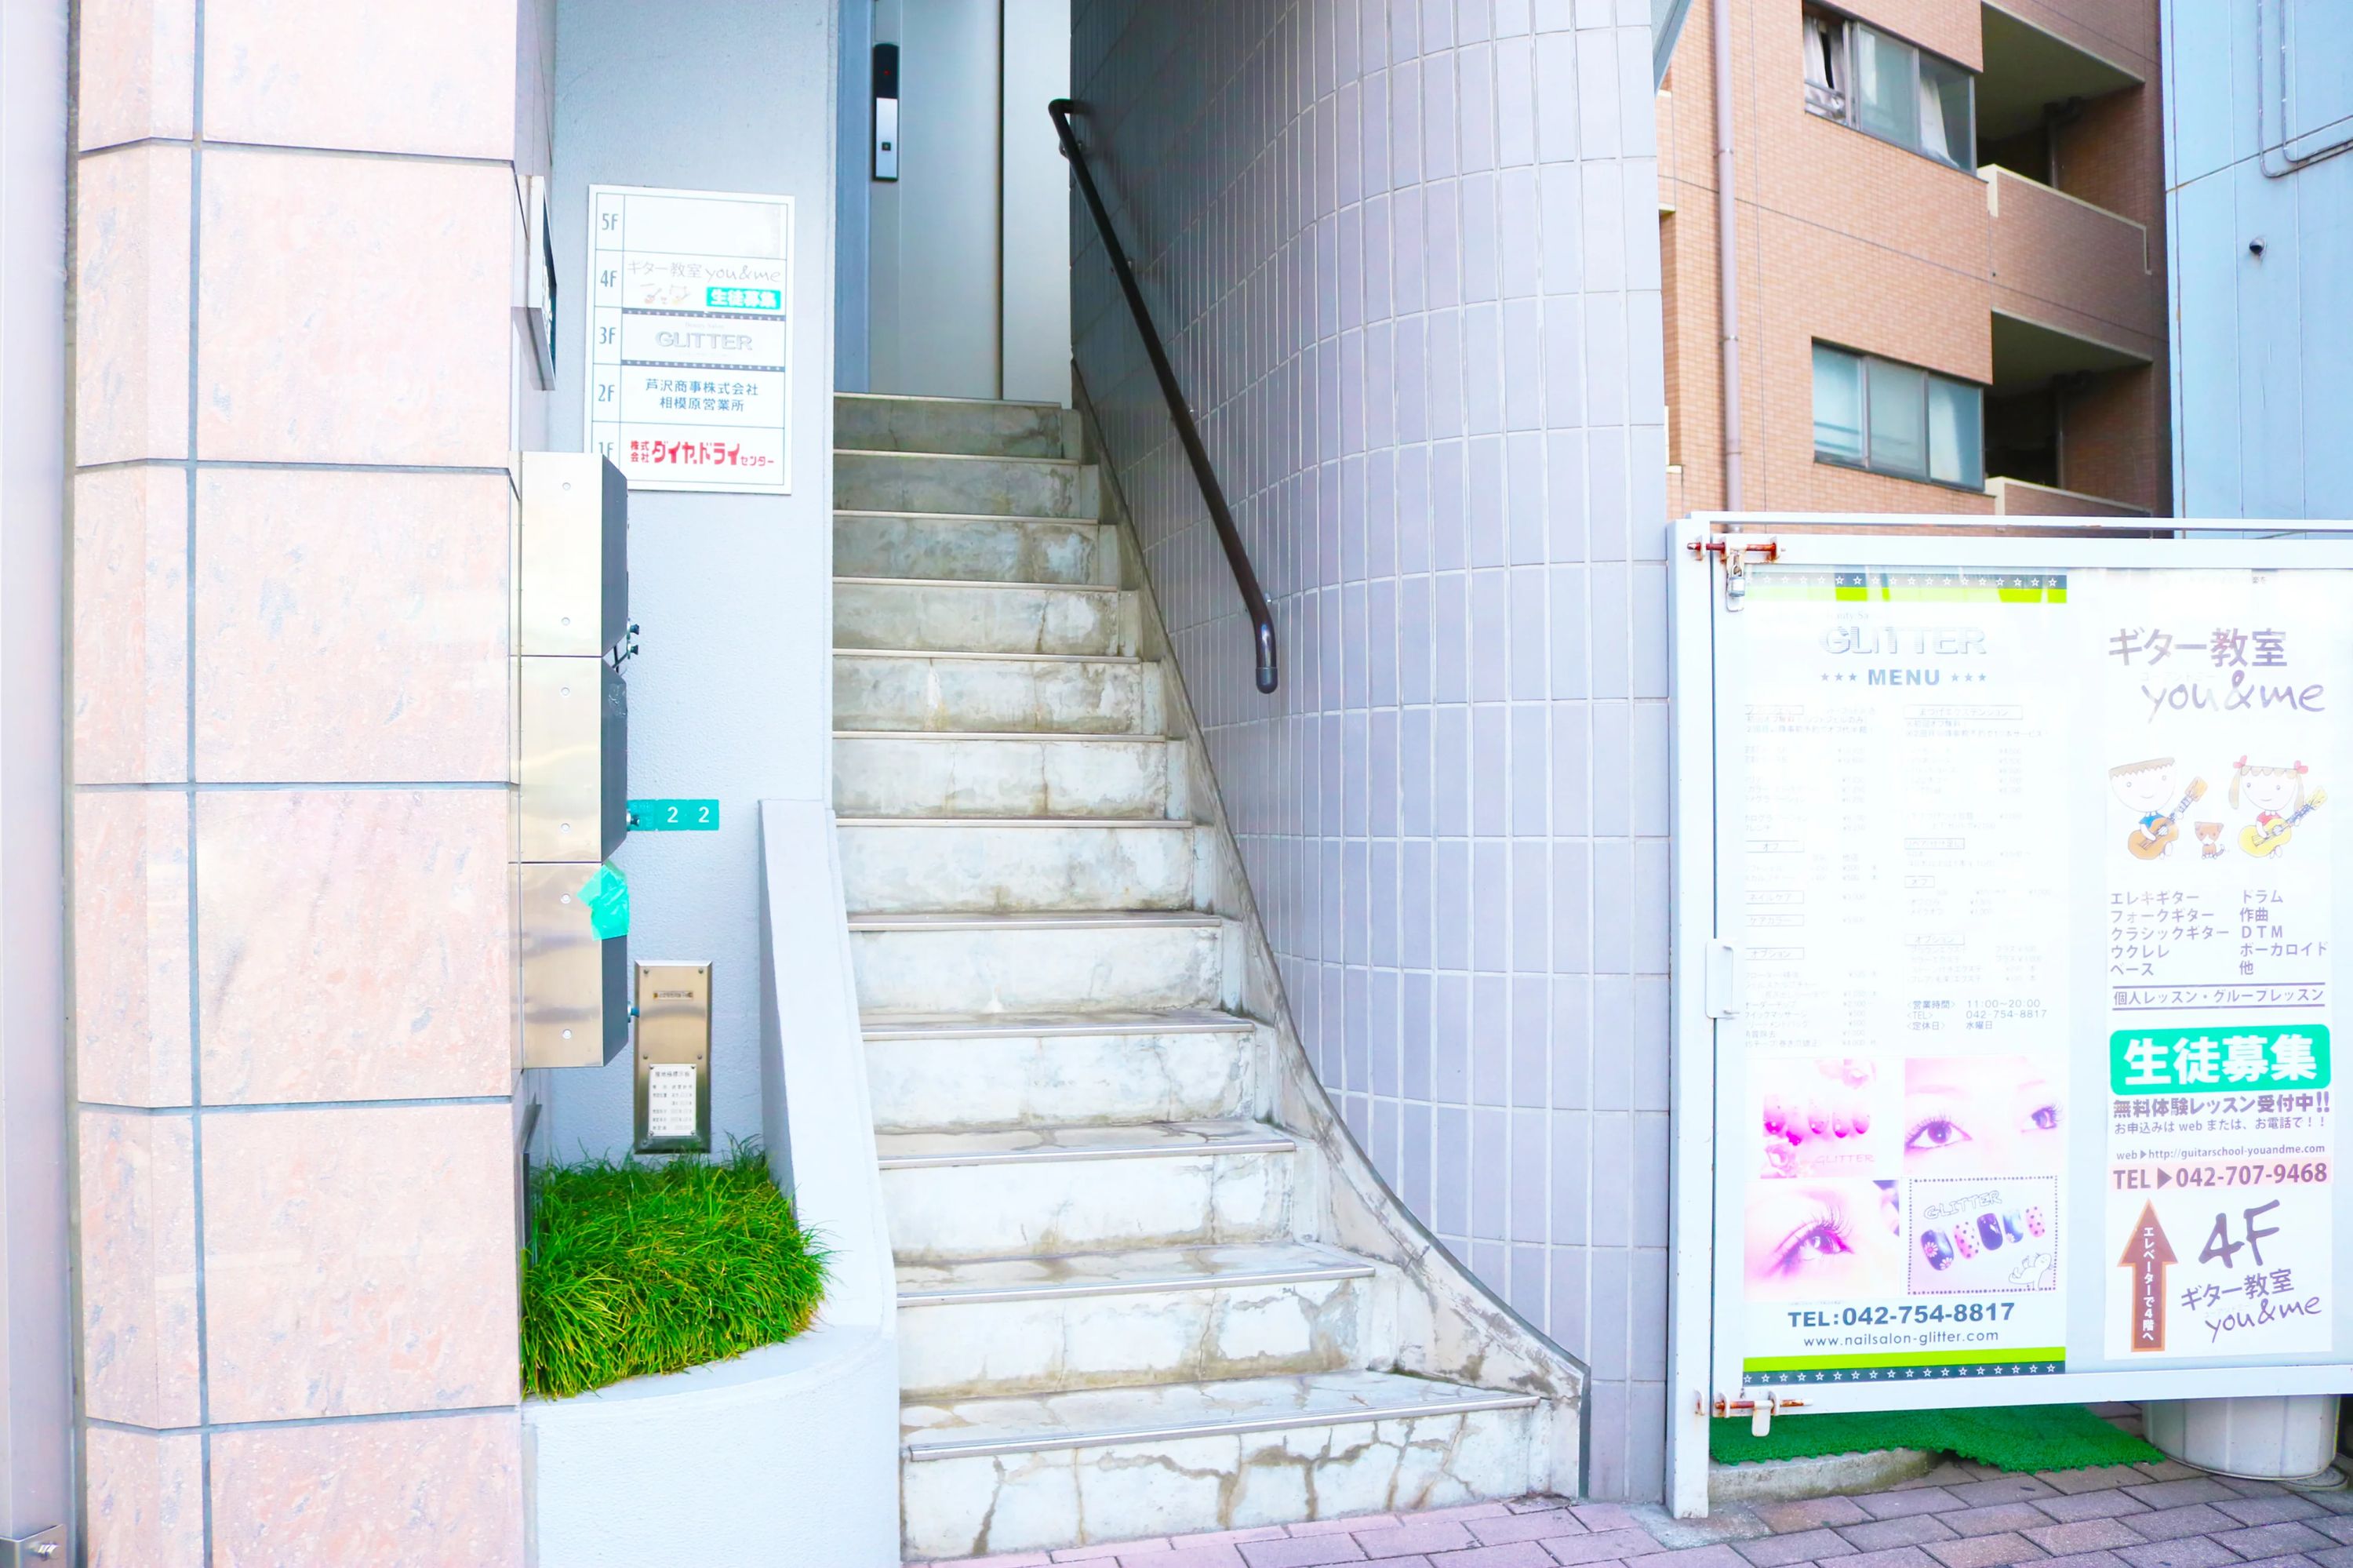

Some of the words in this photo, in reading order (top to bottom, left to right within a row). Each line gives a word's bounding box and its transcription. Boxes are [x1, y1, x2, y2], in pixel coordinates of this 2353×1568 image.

[602, 213, 619, 231] 5F
[600, 269, 617, 288] 4F
[627, 260, 702, 278] ギター教室
[704, 265, 780, 282] you&me
[711, 289, 778, 308] 生徒募集
[599, 326, 616, 344] 3F
[655, 330, 752, 351] GLITTER
[598, 384, 614, 402] 2F
[646, 378, 758, 397] 芦沢商事株式会社
[659, 396, 744, 413] 相模原営業所
[1820, 626, 1988, 656] GLITTER
[2108, 628, 2288, 668] ギター教室
[1867, 668, 1940, 686] MENU
[2140, 669, 2326, 724] you&me
[2111, 890, 2199, 906] エレキギター
[2242, 889, 2283, 904] ドラム
[2111, 908, 2214, 924] フォークギター
[2239, 907, 2268, 922] 作曲
[2111, 925, 2229, 941] クラシックギター
[2111, 944, 2170, 959] ウクレレ
[2240, 941, 2328, 957] ボーカロイド
[2110, 962, 2155, 977] ベース
[2238, 960, 2254, 976] 他
[2113, 988, 2324, 1006] 個人レッスン・グループレッスン
[1966, 1009, 2048, 1020] 042-754-8817
[1966, 1020, 1993, 1031] 水曜日
[2123, 1033, 2318, 1086] 生徒募集
[2114, 1121, 2175, 1134] お申込みは
[2178, 1120, 2203, 1131] web
[1814, 1154, 1875, 1166] GLITTER
[2115, 1148, 2138, 1162] web
[2148, 1144, 2326, 1161] http://guitarschool-youandme.com
[2112, 1169, 2151, 1191] TEL
[2175, 1162, 2328, 1189] 042-707-9468
[1922, 1189, 2003, 1221] GLITTER
[2198, 1198, 2281, 1270] 4F
[2141, 1227, 2156, 1342] エレベーターで4階へ
[2180, 1267, 2295, 1313] ギター教室
[2204, 1296, 2323, 1344] you&me
[1803, 1330, 1999, 1348] www.nailsalon-glitter.com
